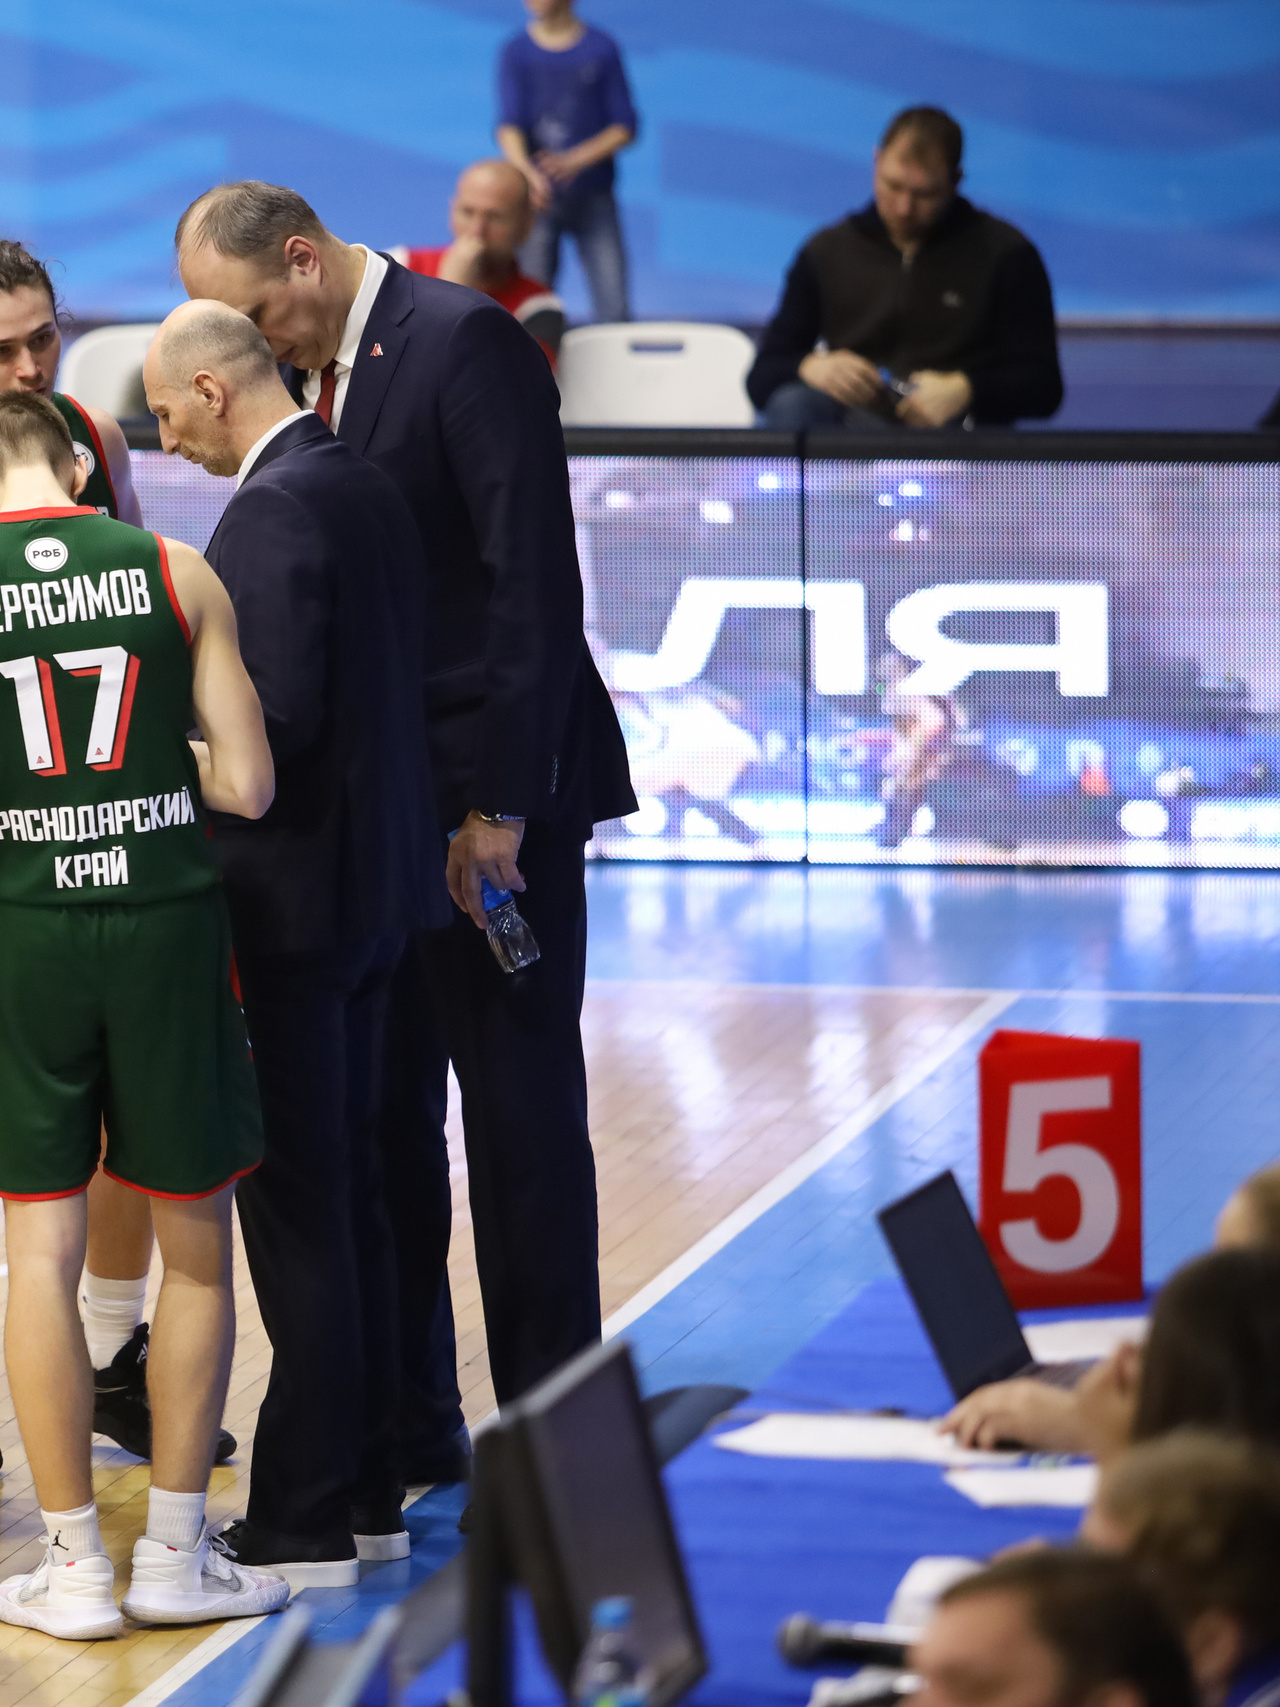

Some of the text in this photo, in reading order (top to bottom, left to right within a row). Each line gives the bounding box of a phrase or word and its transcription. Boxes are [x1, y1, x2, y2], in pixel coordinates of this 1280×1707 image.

[32, 548, 61, 559] РФБ
[53, 846, 129, 889] КРАЙ
[998, 1076, 1120, 1274] 5
